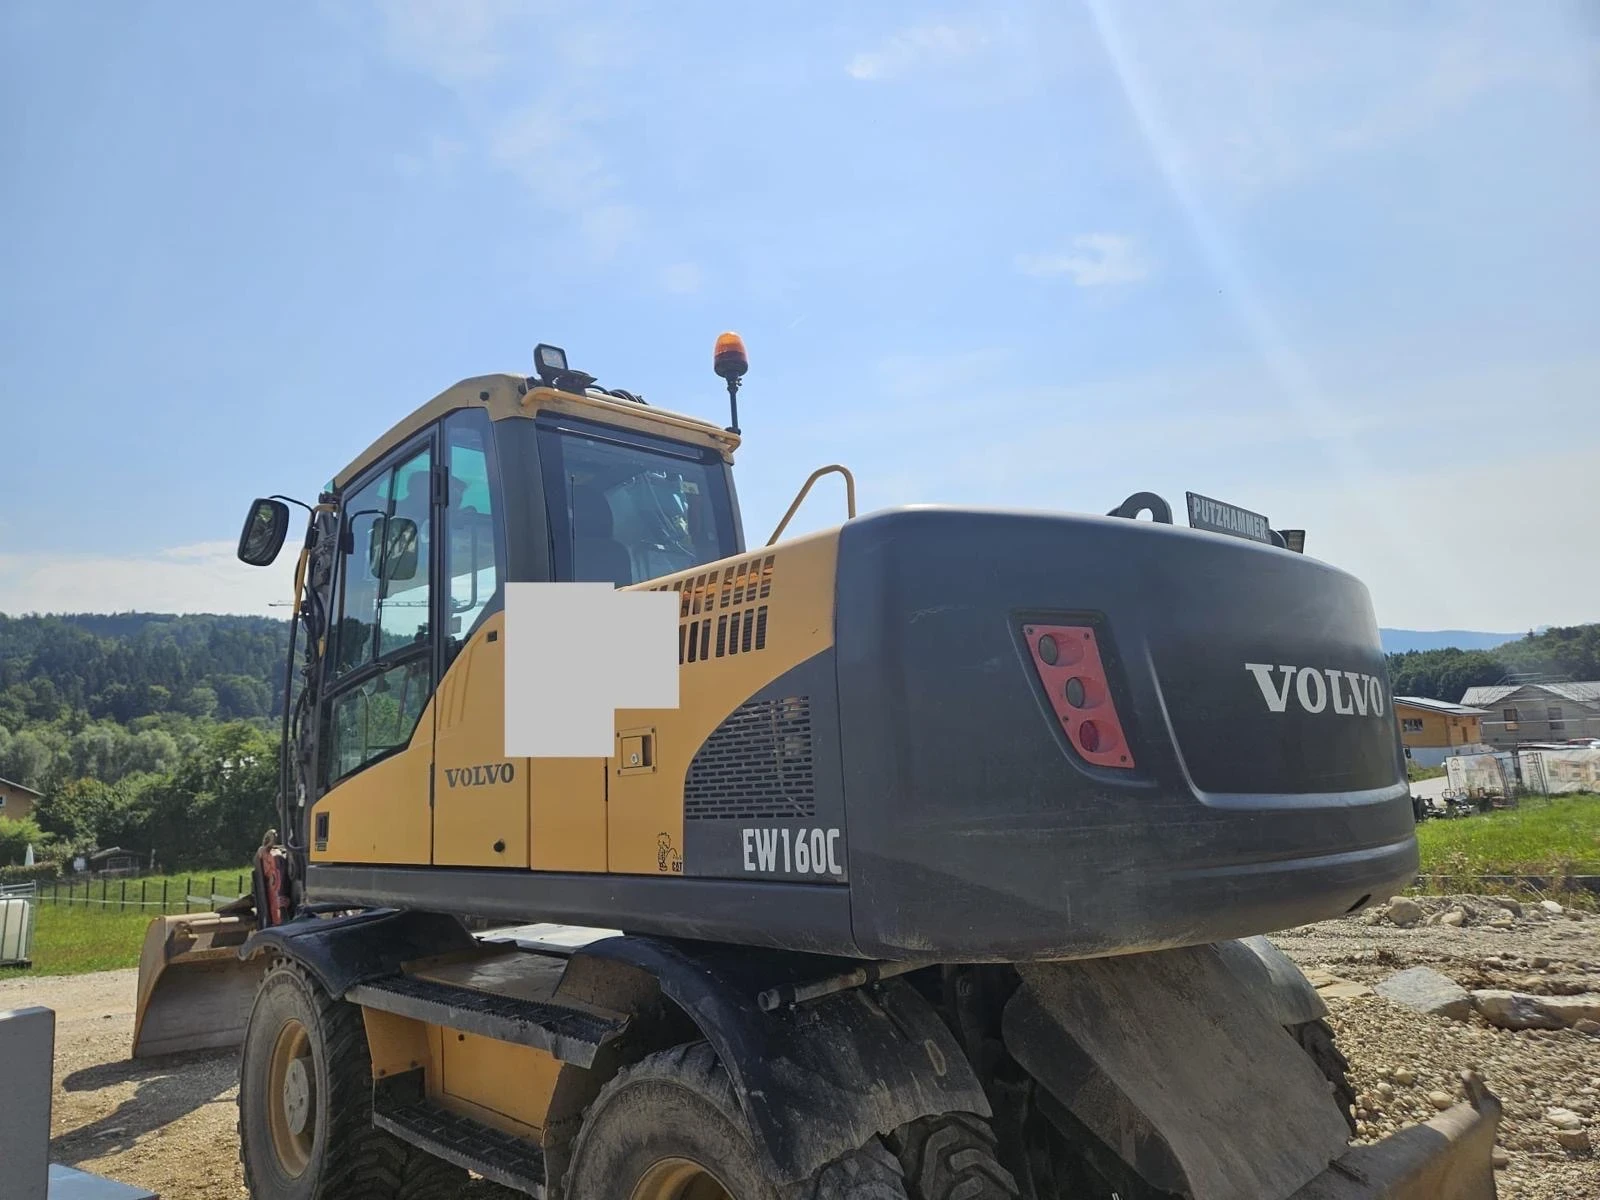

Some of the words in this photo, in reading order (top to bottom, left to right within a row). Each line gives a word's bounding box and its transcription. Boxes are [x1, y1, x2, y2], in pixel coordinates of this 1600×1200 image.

[1192, 497, 1266, 539] PUTZHAMMER
[1245, 663, 1384, 718] VOLVO
[445, 763, 515, 788] VOLVO
[743, 828, 842, 875] EW160C
